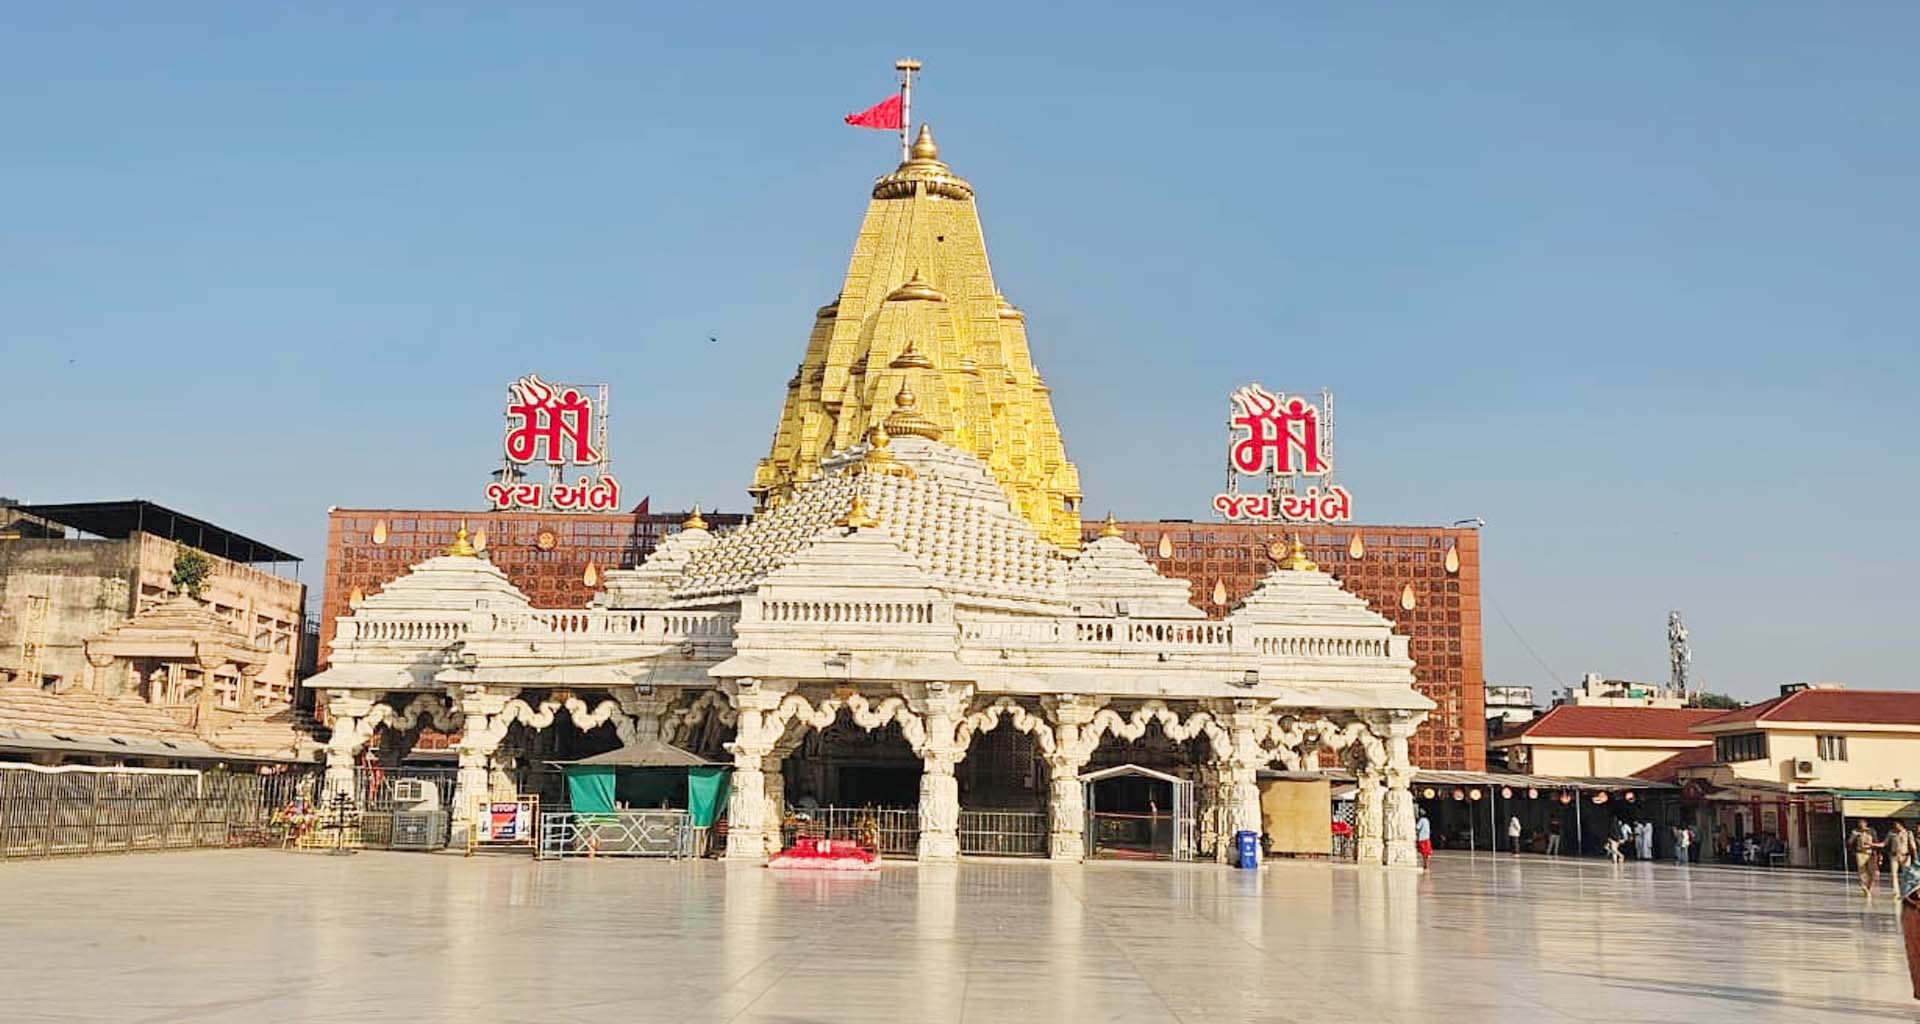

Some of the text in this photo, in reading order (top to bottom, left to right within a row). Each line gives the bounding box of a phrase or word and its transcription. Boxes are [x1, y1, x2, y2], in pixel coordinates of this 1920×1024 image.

[487, 475, 621, 510] જય અંબે
[1213, 485, 1352, 522] જય અંબે
